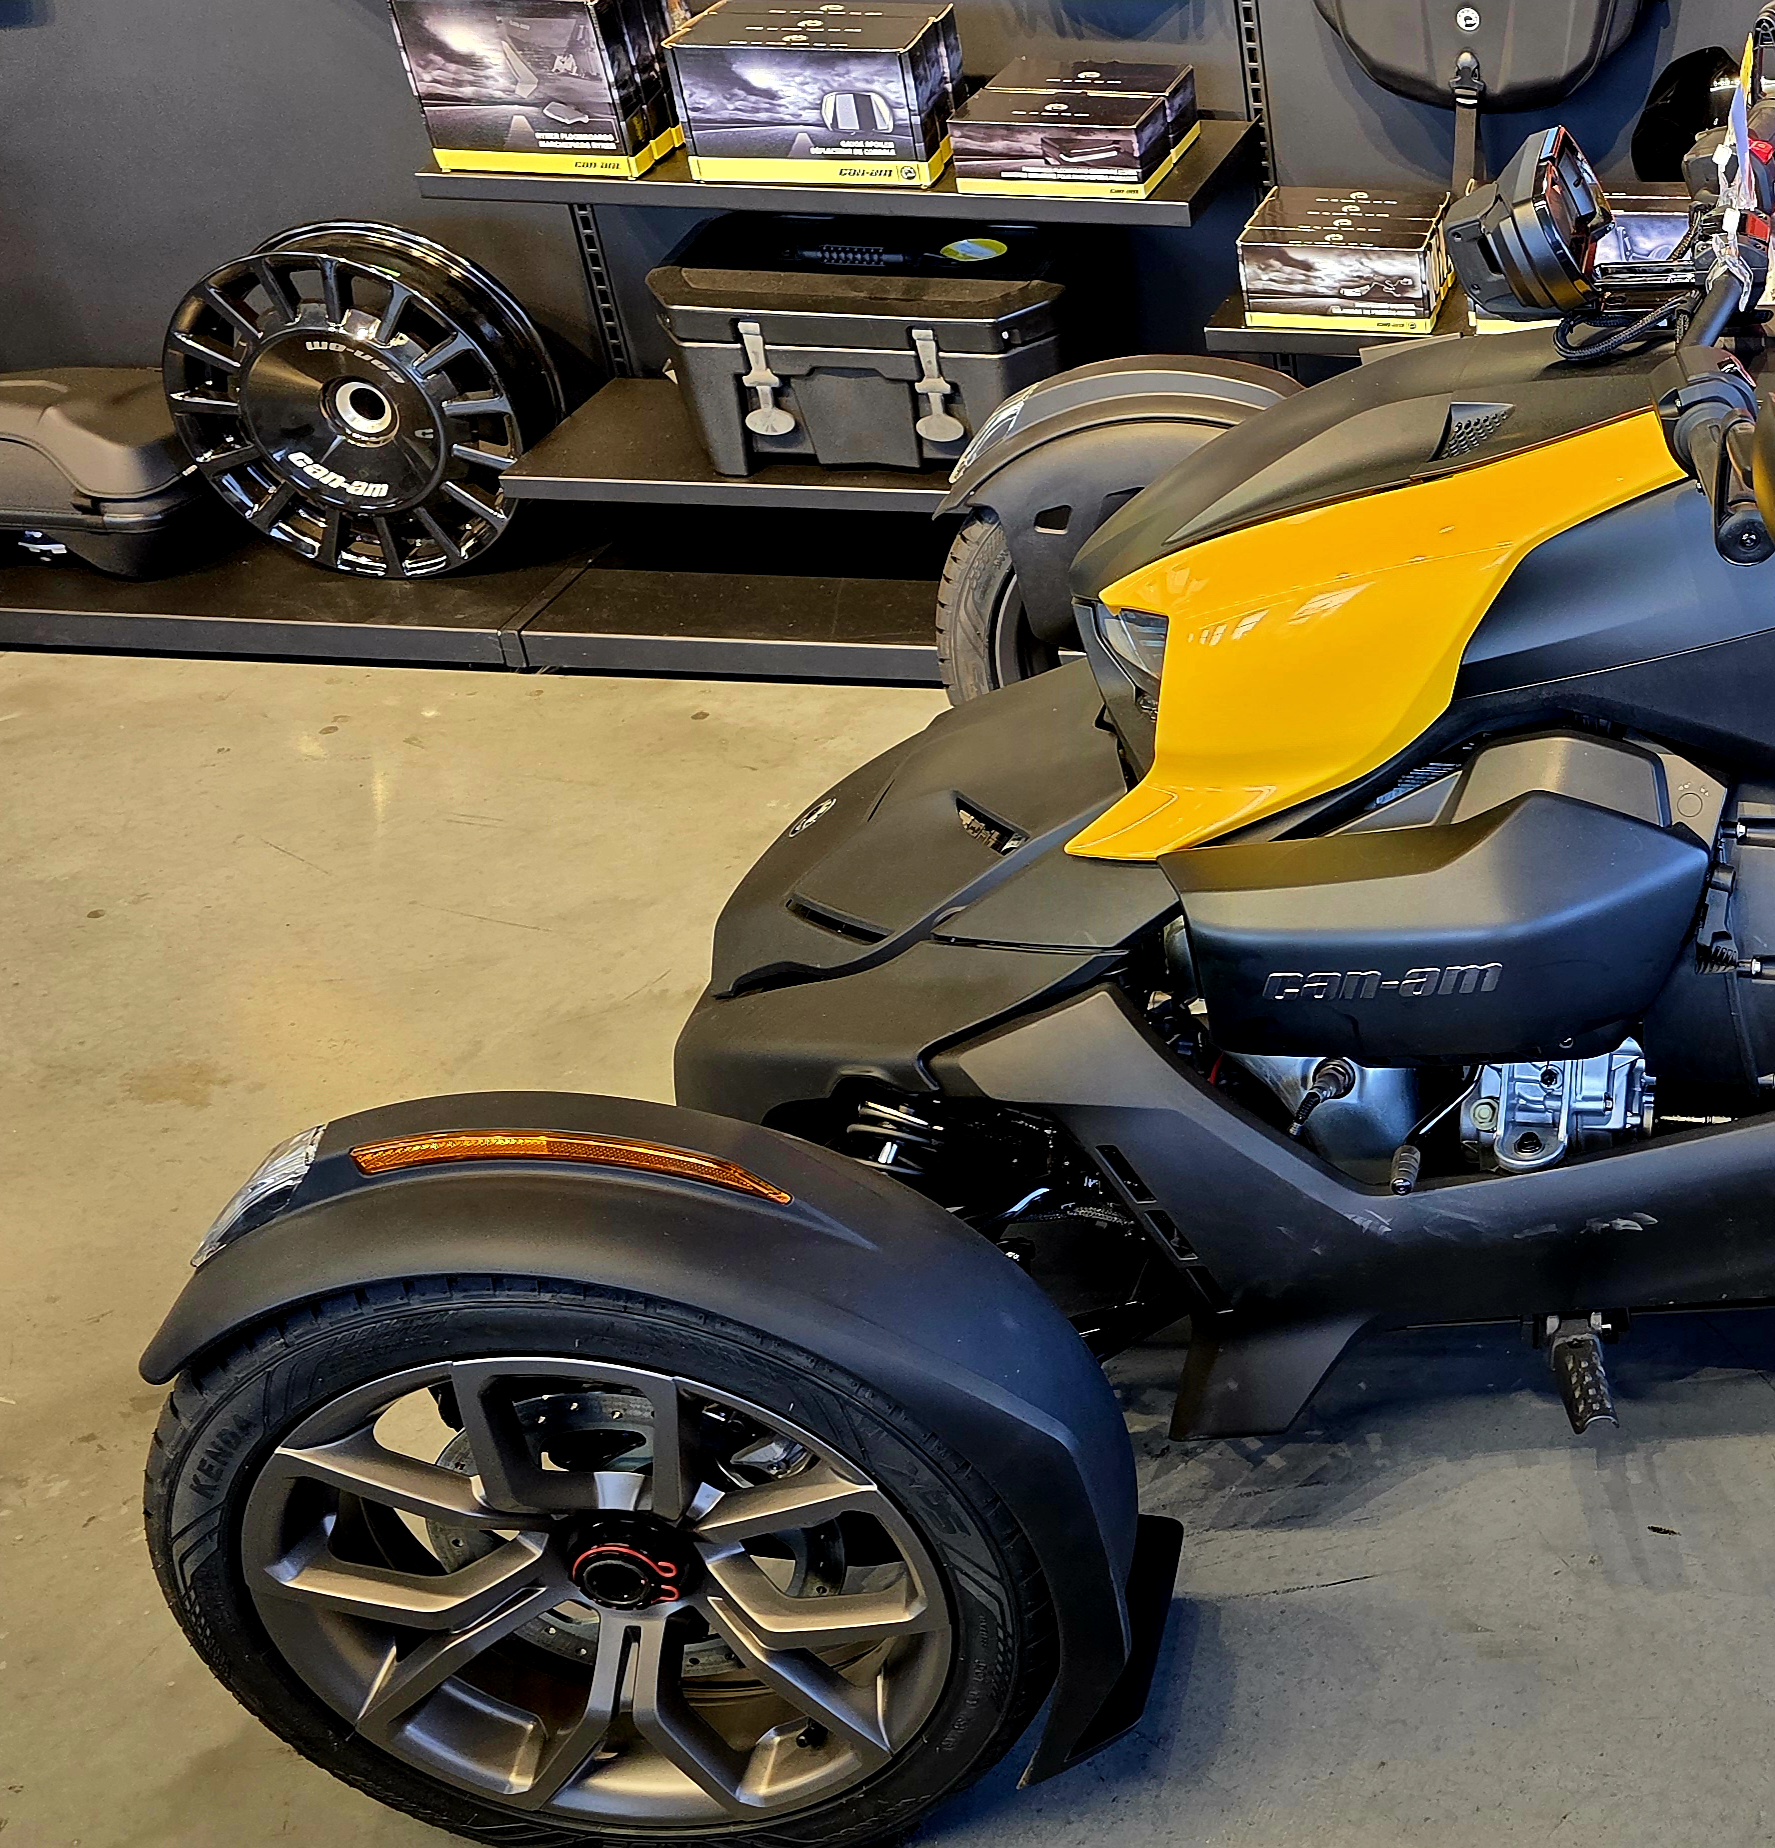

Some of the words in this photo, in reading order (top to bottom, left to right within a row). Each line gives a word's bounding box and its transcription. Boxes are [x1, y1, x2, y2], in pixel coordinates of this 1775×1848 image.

[288, 451, 389, 497] can-am
[1263, 962, 1503, 1000] can-am
[189, 1412, 256, 1500] KENDA
